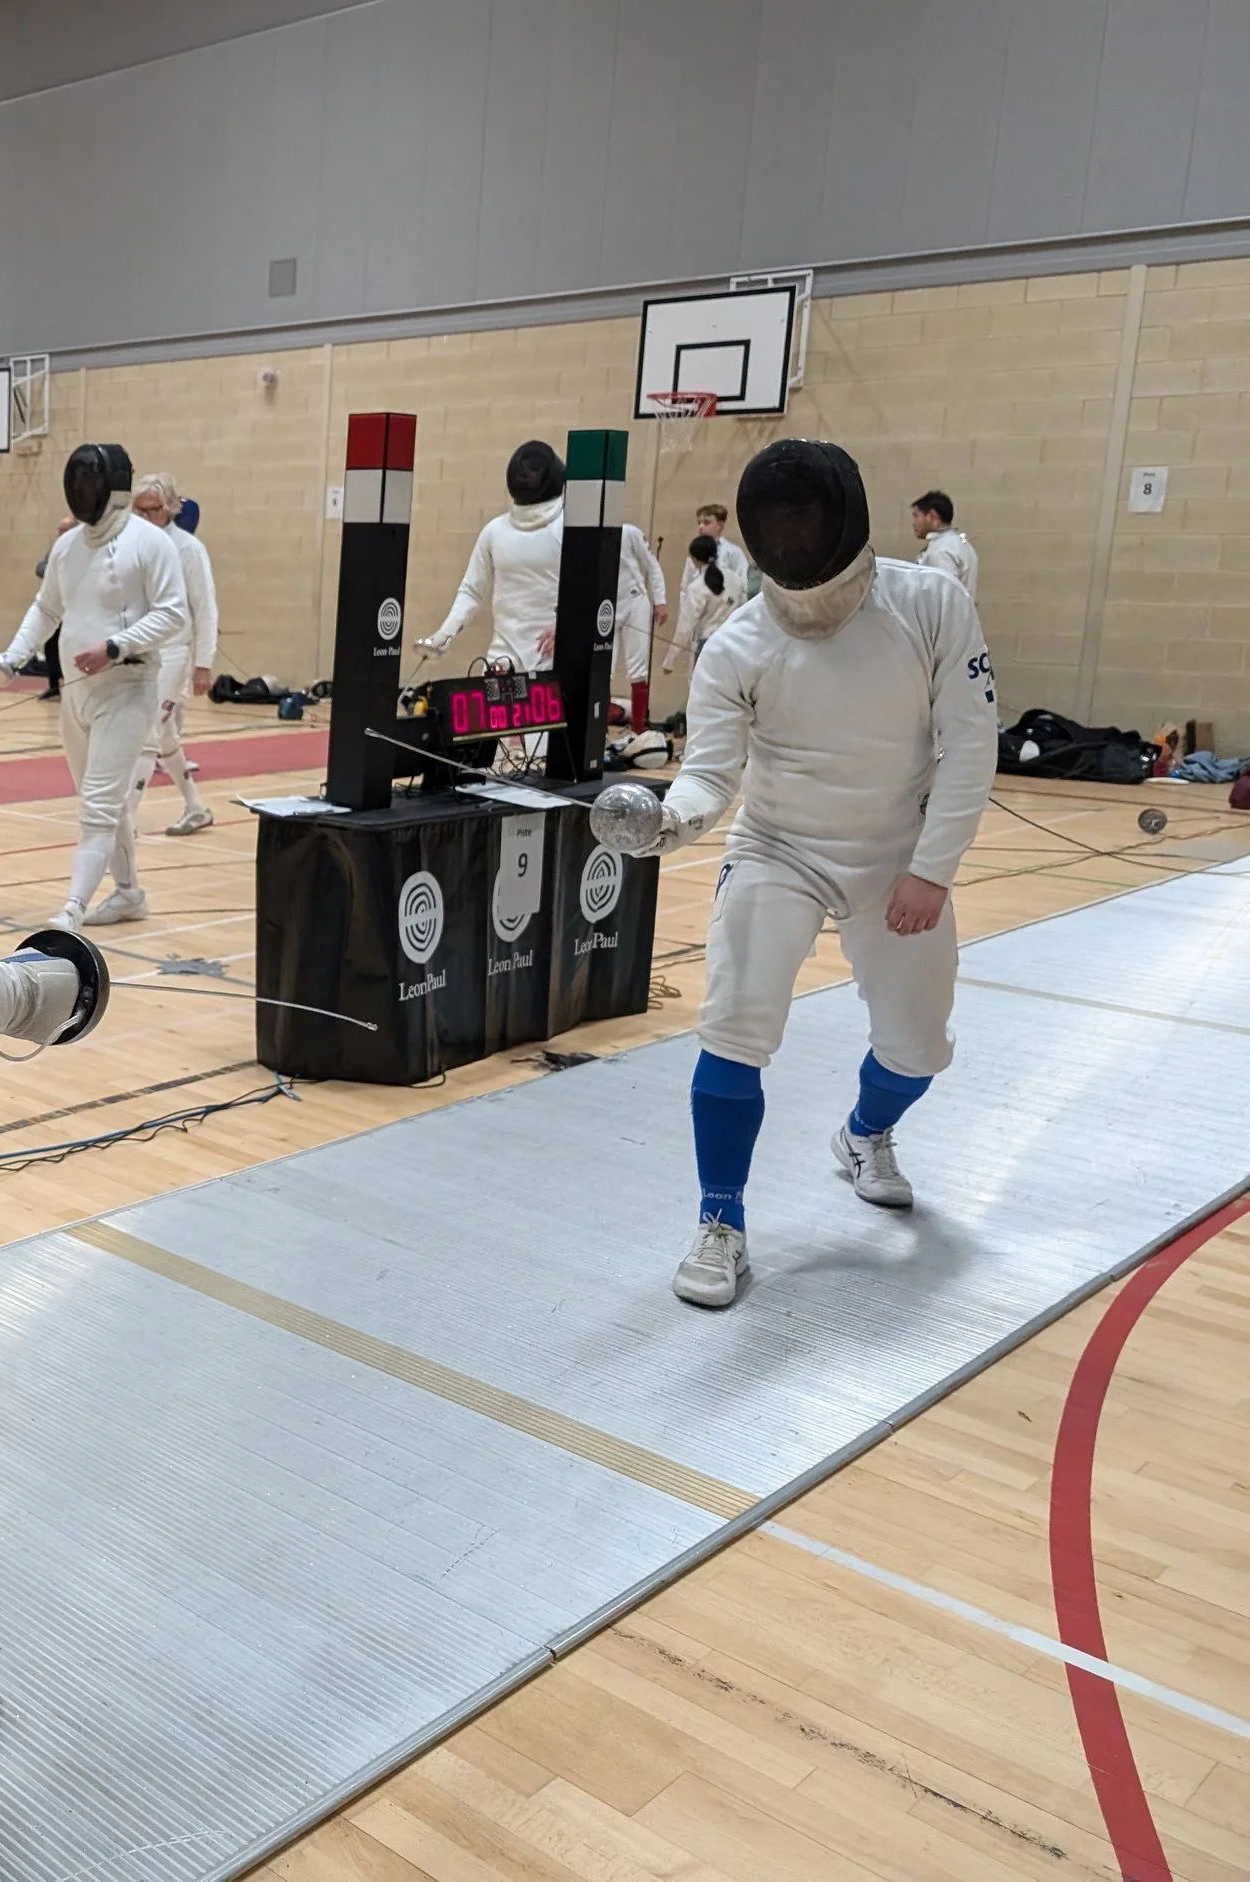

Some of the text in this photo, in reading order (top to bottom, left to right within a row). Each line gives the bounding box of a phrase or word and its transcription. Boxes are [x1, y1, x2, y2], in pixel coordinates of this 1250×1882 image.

[1143, 482, 1152, 495] 8
[967, 652, 994, 680] SC
[452, 692, 486, 734] 07
[518, 852, 528, 878] 9
[592, 932, 618, 949] Paul
[488, 949, 533, 976] Leon Paul
